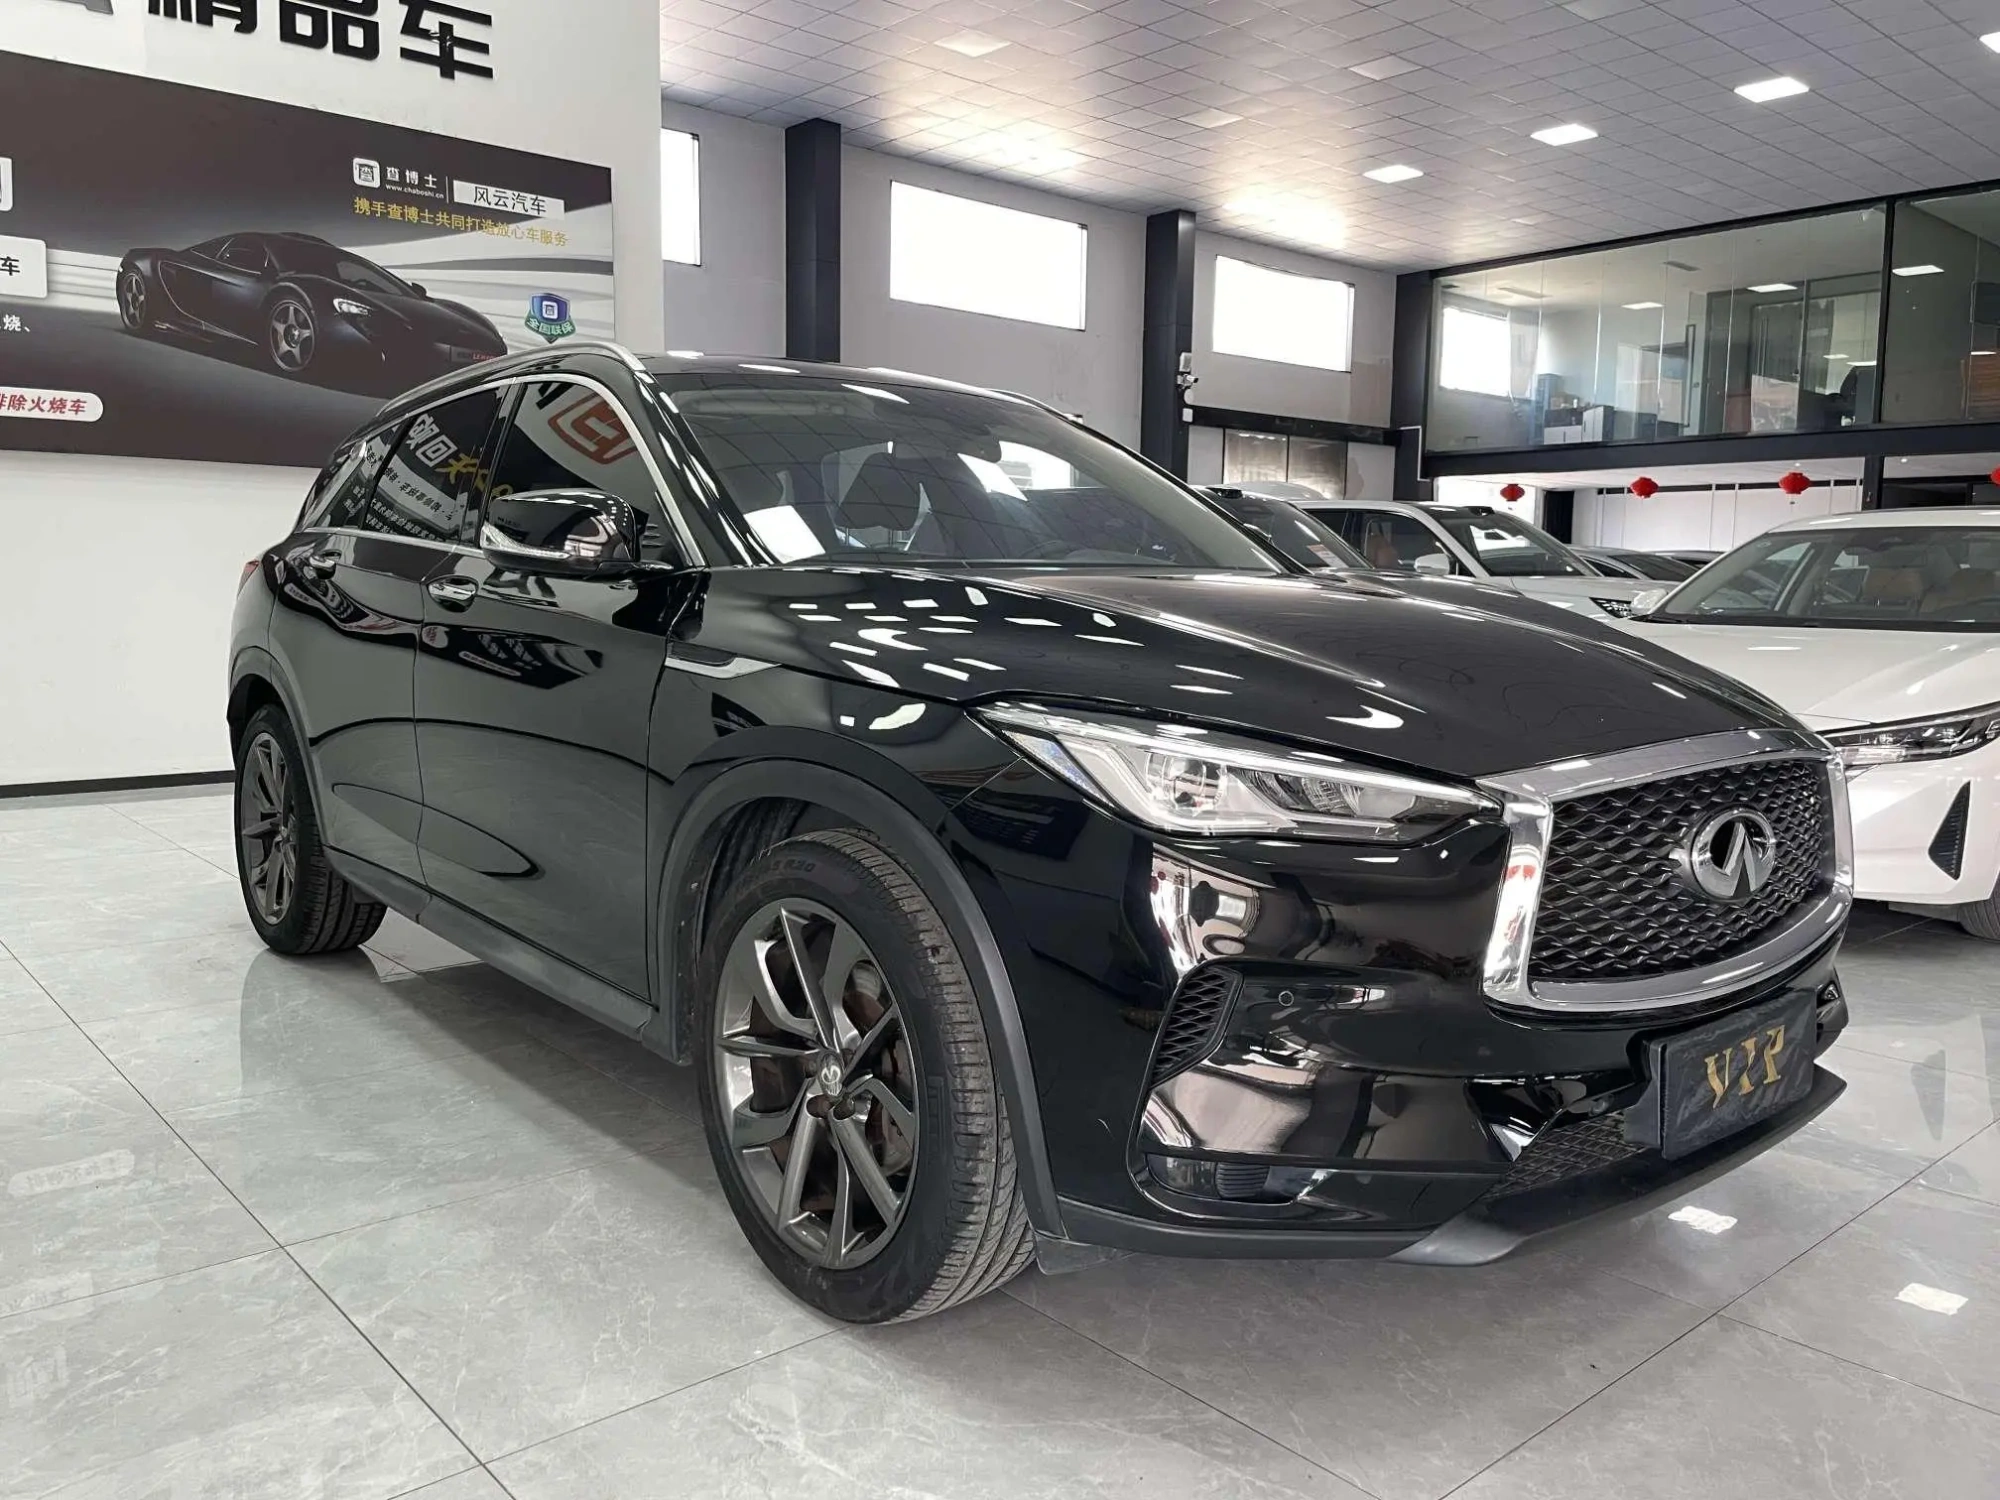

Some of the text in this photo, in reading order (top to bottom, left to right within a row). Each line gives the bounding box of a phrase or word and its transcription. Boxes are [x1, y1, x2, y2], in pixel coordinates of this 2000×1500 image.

[386, 166, 437, 188] 查博士
[385, 183, 444, 199] www.chaboshi.cn
[473, 186, 547, 215] 风云汽车
[354, 197, 568, 247] 携手查博士共同打造放心车服务
[526, 318, 574, 336] 全国联保
[1704, 1025, 1785, 1110] VIP
